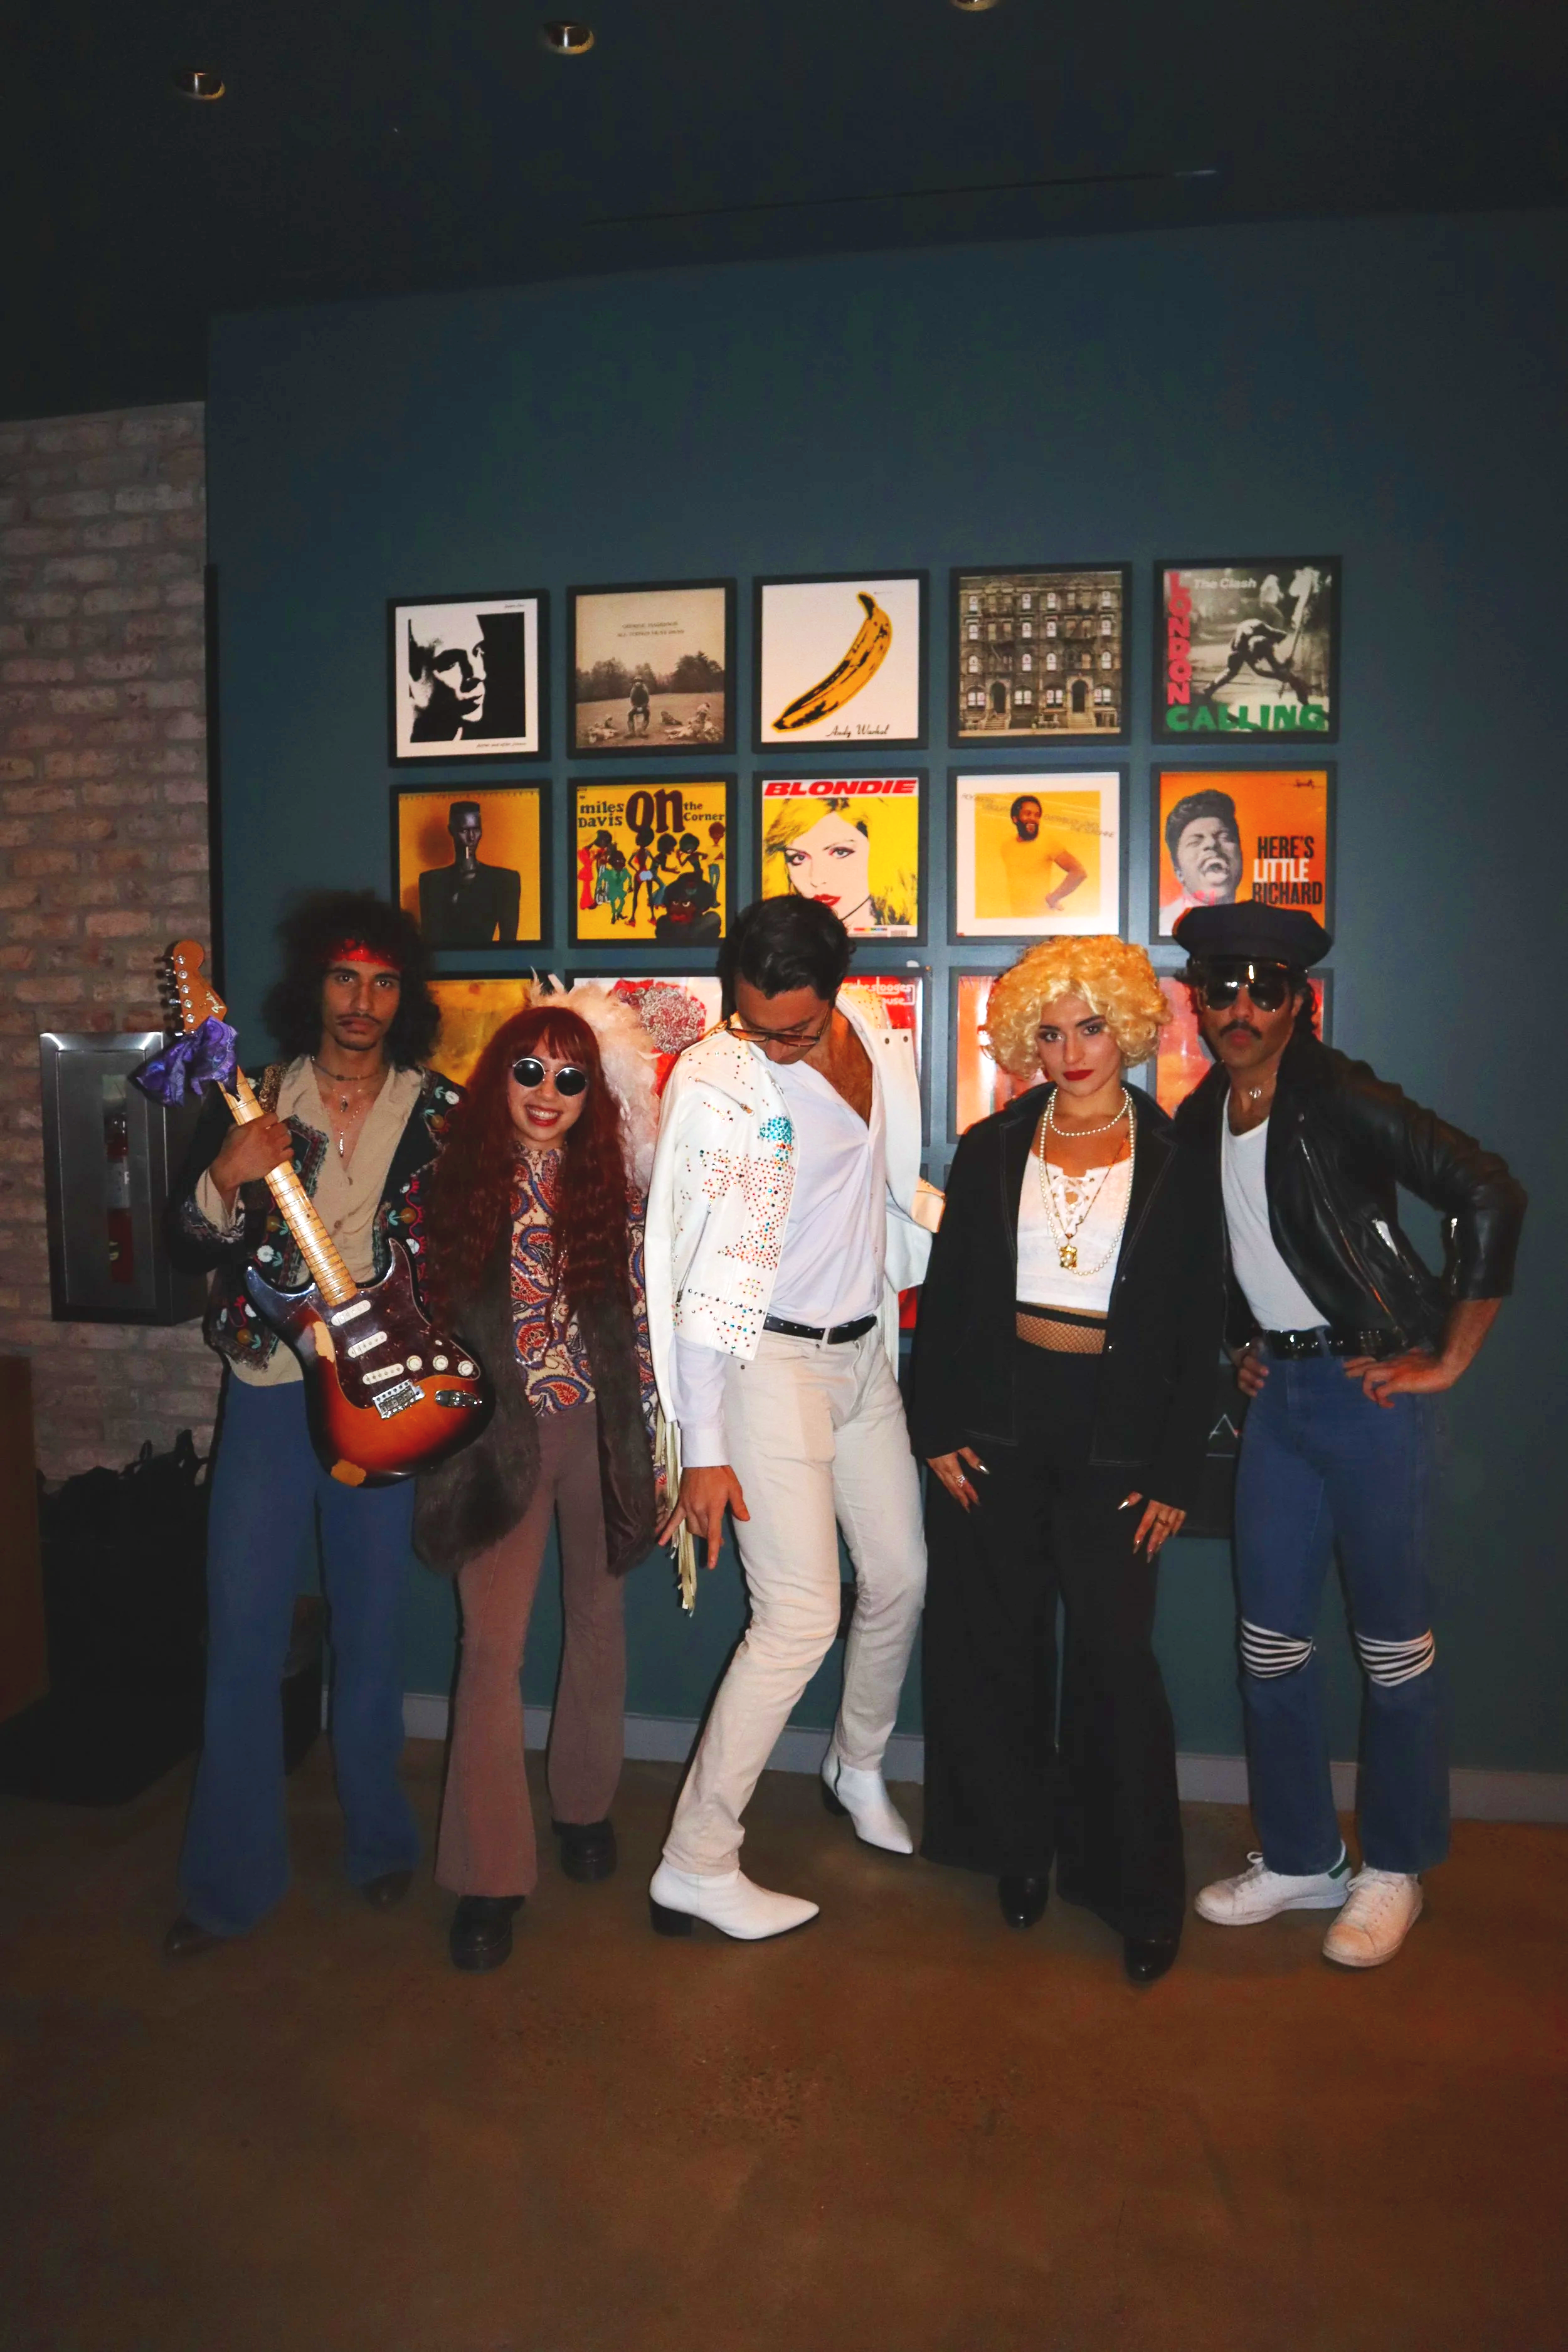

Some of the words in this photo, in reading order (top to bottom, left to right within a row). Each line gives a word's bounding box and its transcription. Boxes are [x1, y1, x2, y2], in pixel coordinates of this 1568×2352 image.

[1220, 578, 1257, 590] Clash
[1167, 572, 1192, 705] LONDON
[1165, 704, 1326, 732] CALLING
[825, 725, 852, 738] Andy
[856, 724, 889, 734] Warhol
[765, 780, 917, 795] BLONDIE
[580, 801, 624, 814] miles
[684, 802, 702, 810] the
[578, 813, 623, 828] Davis
[683, 812, 725, 821] Corner
[1258, 835, 1314, 859] HERE'S
[1253, 858, 1310, 882] LITTLE
[1252, 881, 1323, 904] RICHARD
